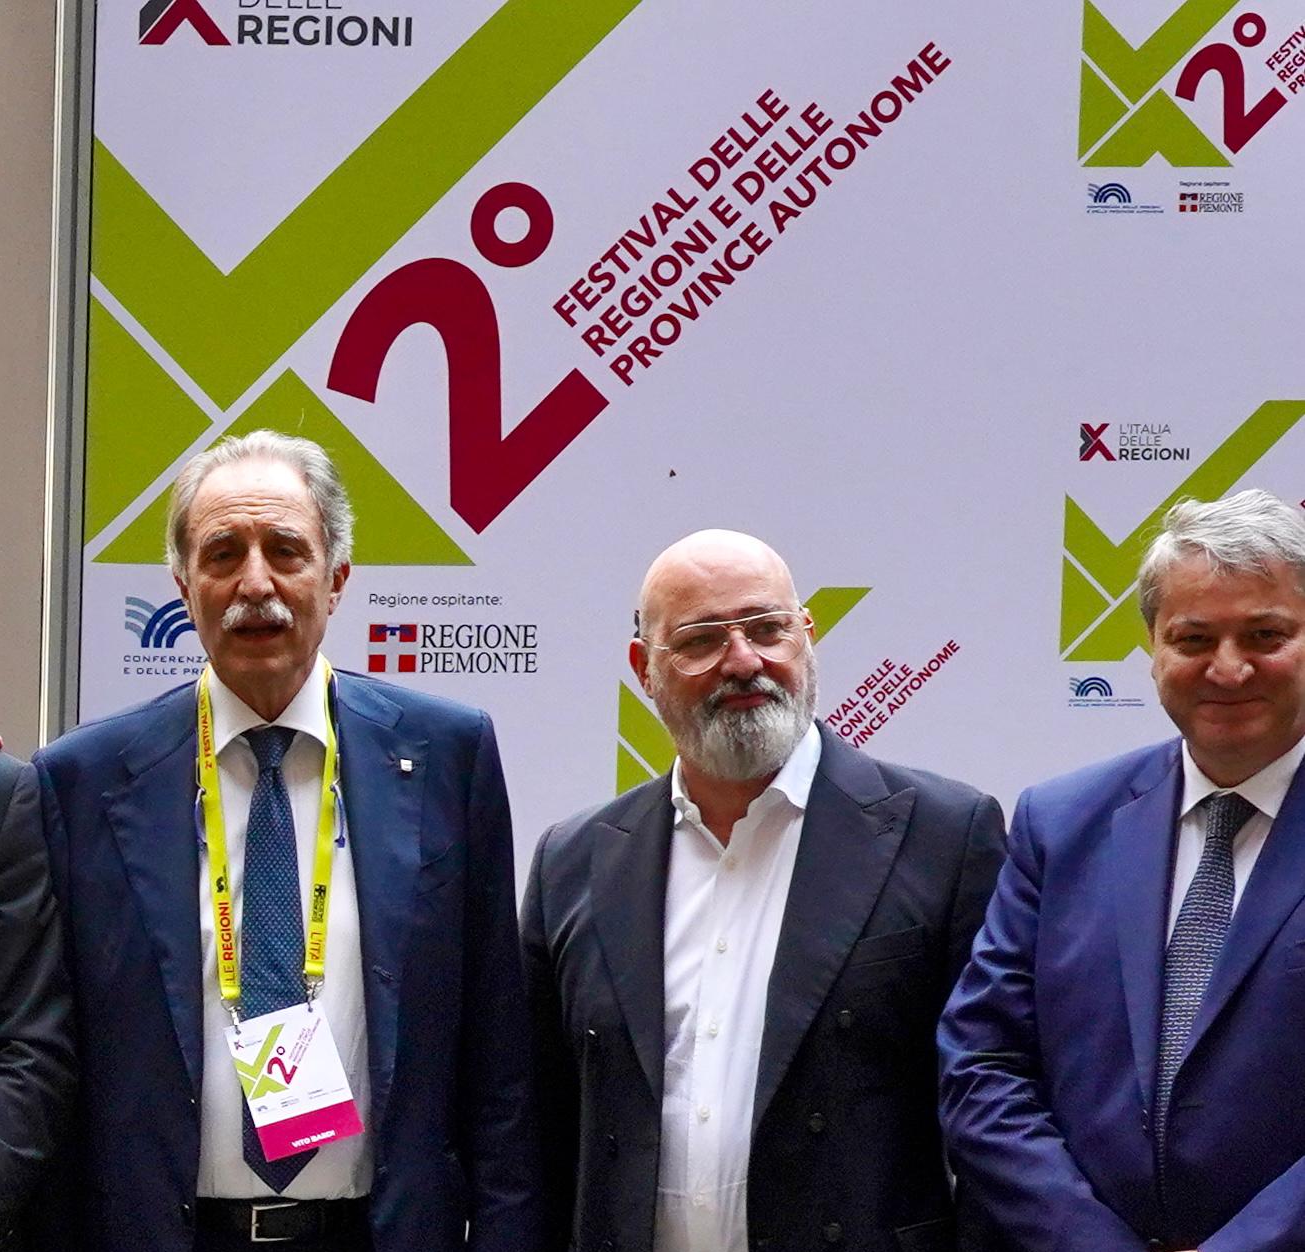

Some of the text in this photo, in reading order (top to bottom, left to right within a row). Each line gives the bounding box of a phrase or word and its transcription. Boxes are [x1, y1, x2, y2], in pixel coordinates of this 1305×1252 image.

[238, 15, 413, 46] REGIONI
[552, 88, 790, 328] FESTIVAL DELLE
[1199, 193, 1244, 202] REGIONE
[1199, 204, 1244, 213] PIEMONTE
[609, 41, 952, 386] PROVINCE AUTONOME
[581, 102, 834, 357] REGIONI E DELLE
[1119, 424, 1171, 435] L'ITALIA
[1119, 435, 1162, 446] DELLE
[1118, 448, 1190, 461] REGIONI
[369, 593, 503, 607] Regione ospitante:
[420, 624, 538, 649] REGIONE
[123, 667, 131, 675] E
[136, 667, 177, 675] DELLE
[420, 652, 538, 674] PIEMONTE
[855, 658, 896, 699] DELLE
[863, 701, 877, 714] E
[873, 663, 913, 705] DELLE
[887, 639, 960, 716] AUTONOME
[217, 901, 234, 961] REGIONI
